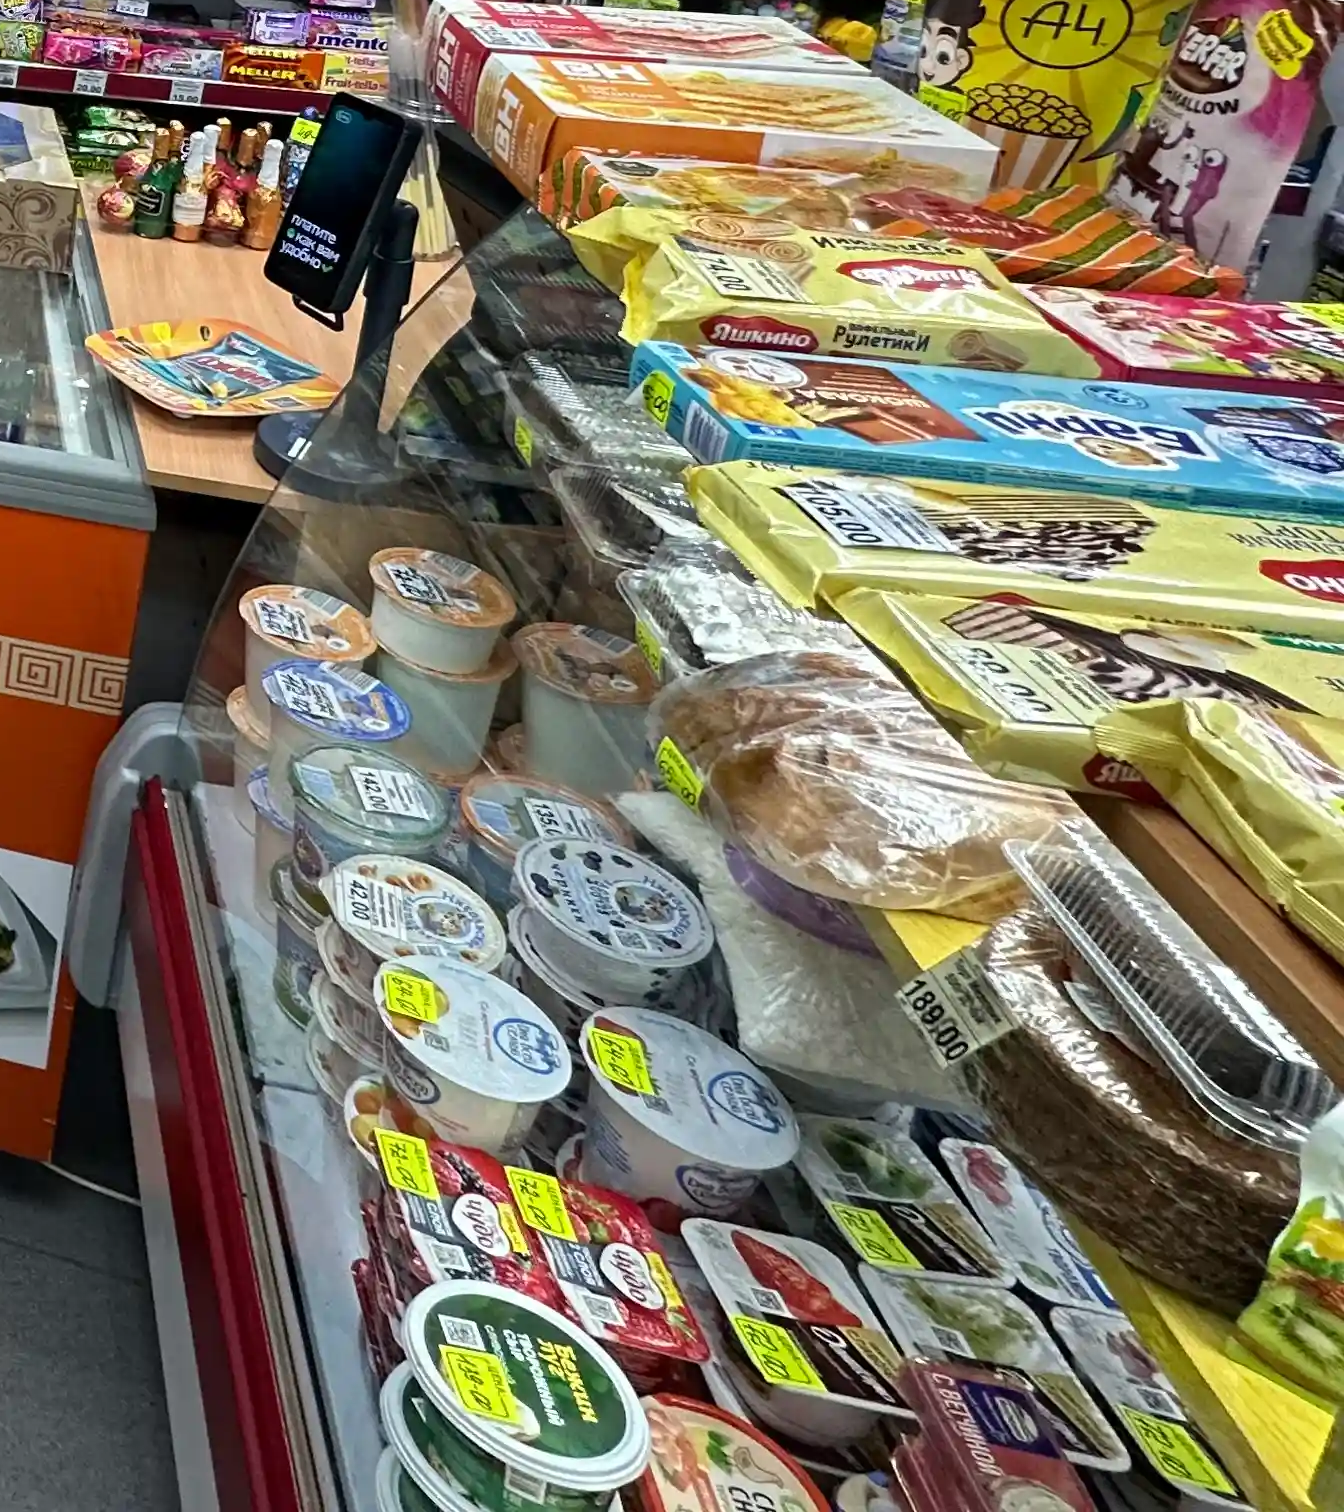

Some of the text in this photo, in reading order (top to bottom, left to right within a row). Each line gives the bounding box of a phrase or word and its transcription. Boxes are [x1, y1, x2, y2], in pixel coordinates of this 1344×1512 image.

[1021, 0, 1106, 47] A4
[318, 35, 389, 52] mento
[229, 65, 297, 80] MELLER
[551, 60, 651, 81] BH
[494, 88, 523, 164] BH
[291, 214, 337, 245] платите
[278, 239, 322, 270] удобно
[296, 233, 341, 264] как вам
[711, 322, 812, 349] Яшкино
[976, 409, 1211, 458] Барни
[554, 1343, 598, 1424] Бежин
